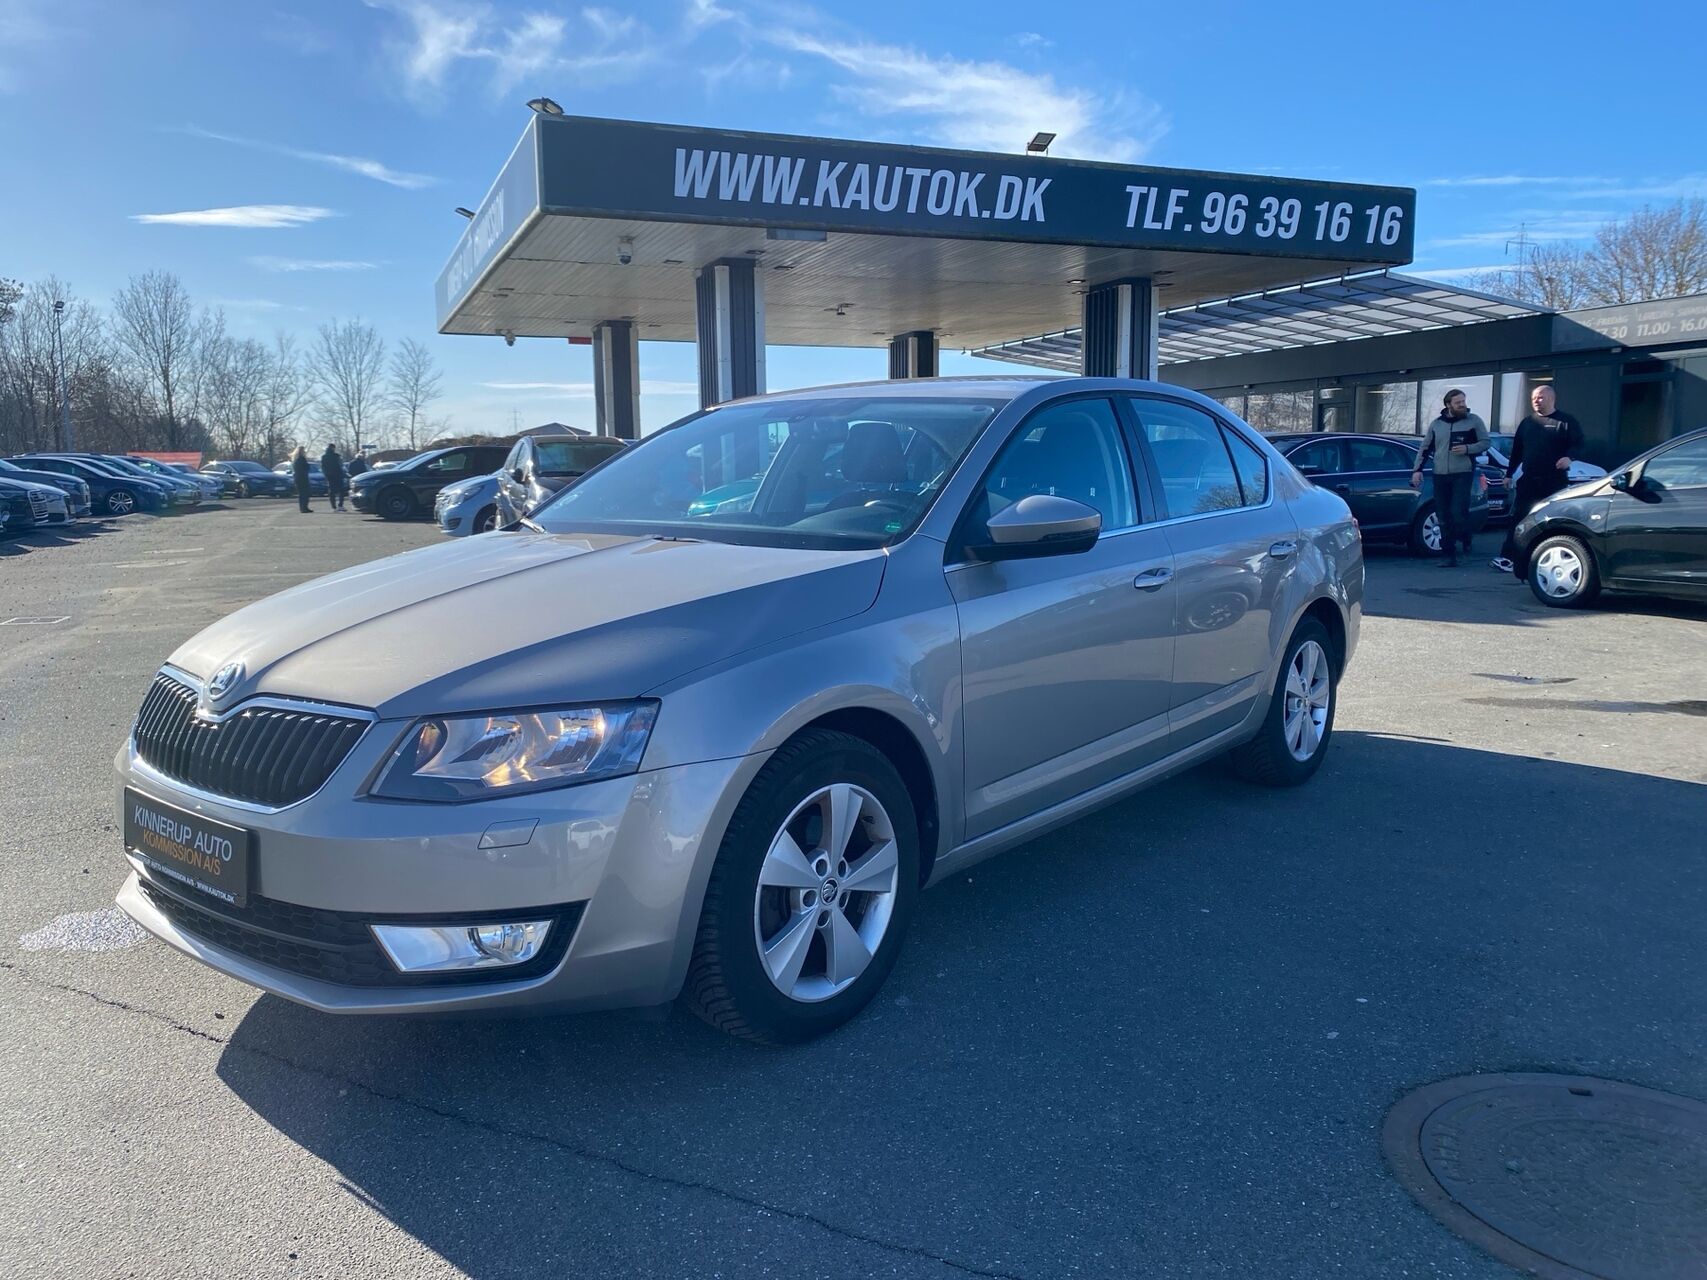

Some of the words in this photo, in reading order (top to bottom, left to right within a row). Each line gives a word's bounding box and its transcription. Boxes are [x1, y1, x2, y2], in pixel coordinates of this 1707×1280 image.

[674, 148, 1052, 223] WWW.KAUTOK.DK
[1125, 185, 1192, 232] TLF.
[1200, 191, 1249, 235] 96
[1255, 196, 1302, 239] 39
[1314, 201, 1353, 242] 16
[1365, 205, 1403, 245] 16
[1637, 321, 1671, 337] 11.00
[134, 804, 192, 845] KINNERUP
[194, 830, 232, 862] AUTO
[143, 829, 201, 869] KOMMISSION
[203, 855, 221, 876] A/S
